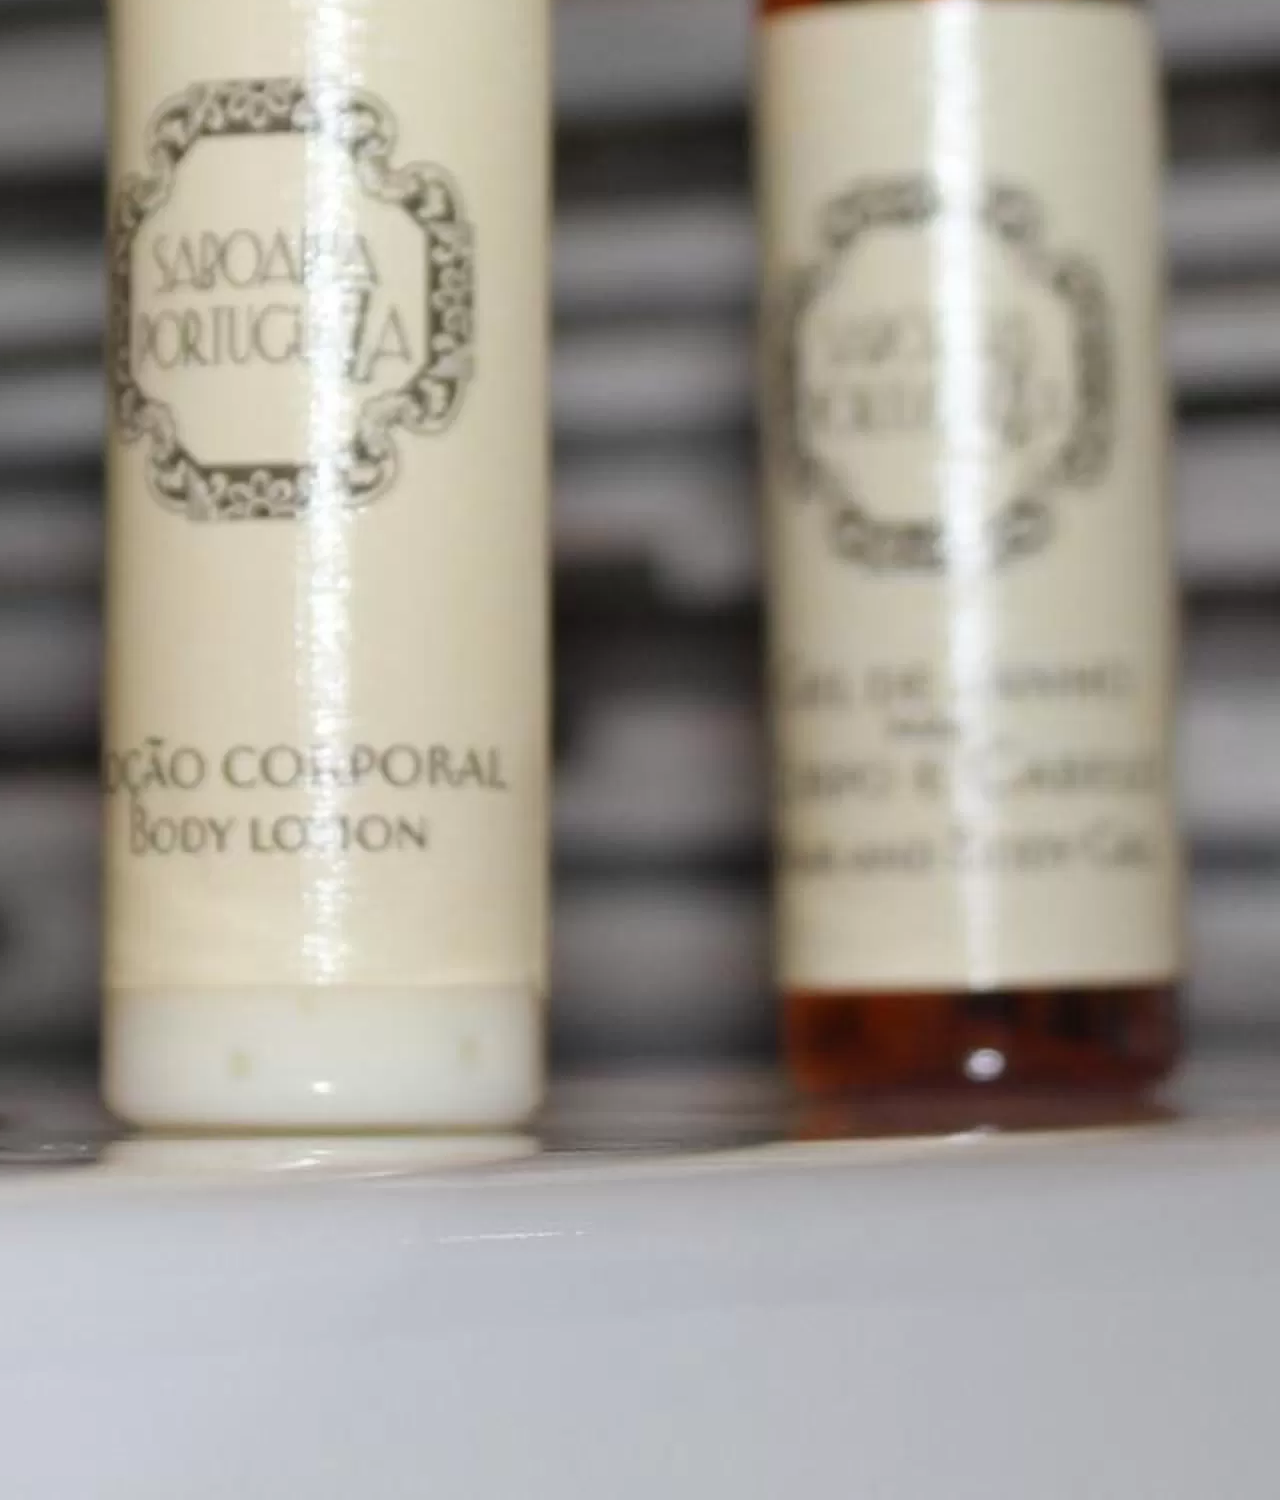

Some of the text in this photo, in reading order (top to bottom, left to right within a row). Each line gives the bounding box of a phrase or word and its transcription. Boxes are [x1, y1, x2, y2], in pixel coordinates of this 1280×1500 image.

[137, 285, 412, 383] PORTUGZA
[106, 737, 508, 798] OÇÃO CORPORAL
[129, 804, 236, 856] BODY
